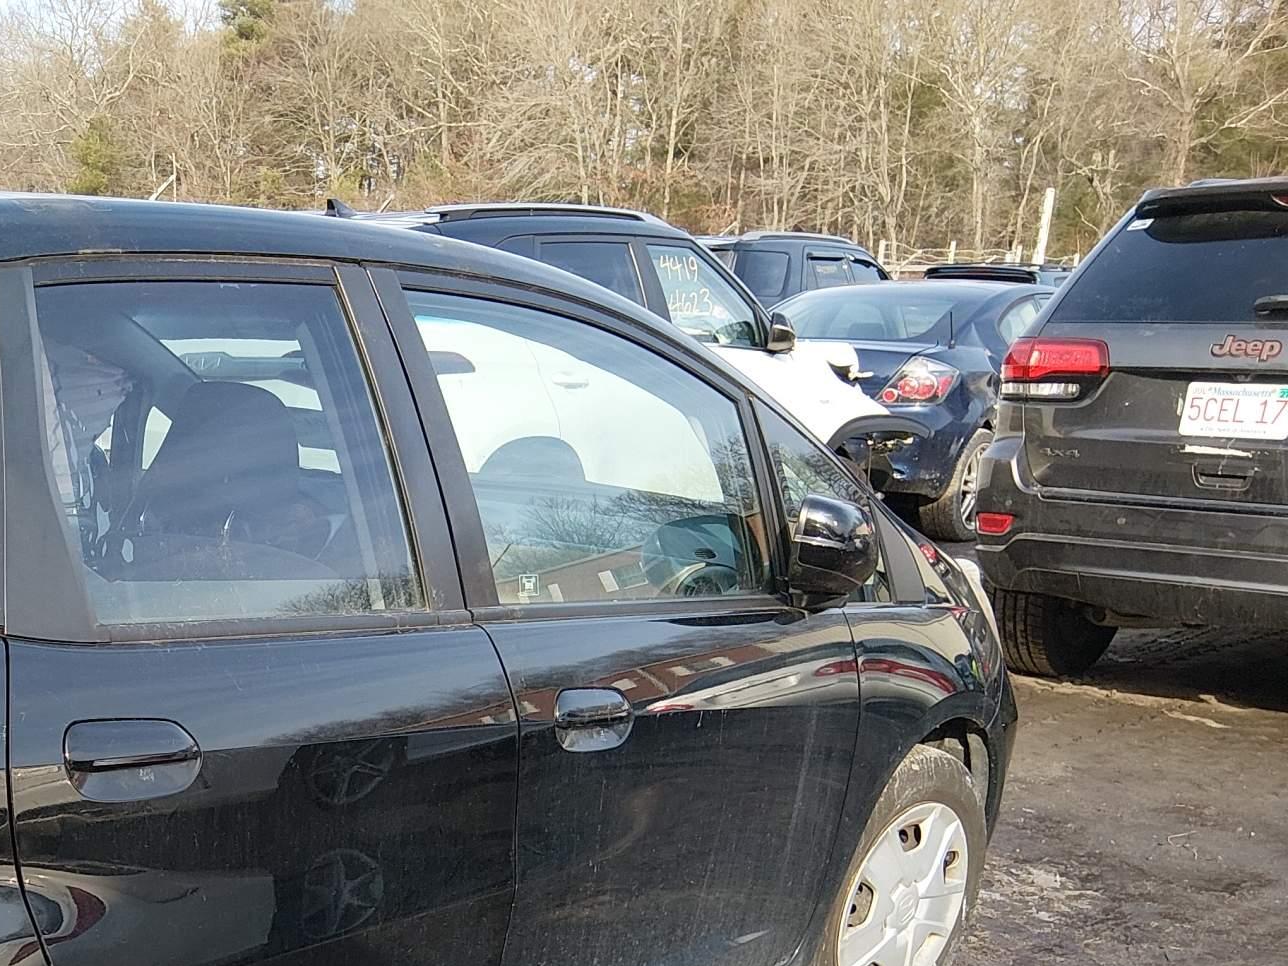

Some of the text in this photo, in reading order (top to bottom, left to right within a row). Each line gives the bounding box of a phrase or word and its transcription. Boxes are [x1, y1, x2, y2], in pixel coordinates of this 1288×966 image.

[660, 255, 698, 282] 4419
[1210, 334, 1283, 362] Jeep
[1188, 397, 1244, 422] 5CEL
